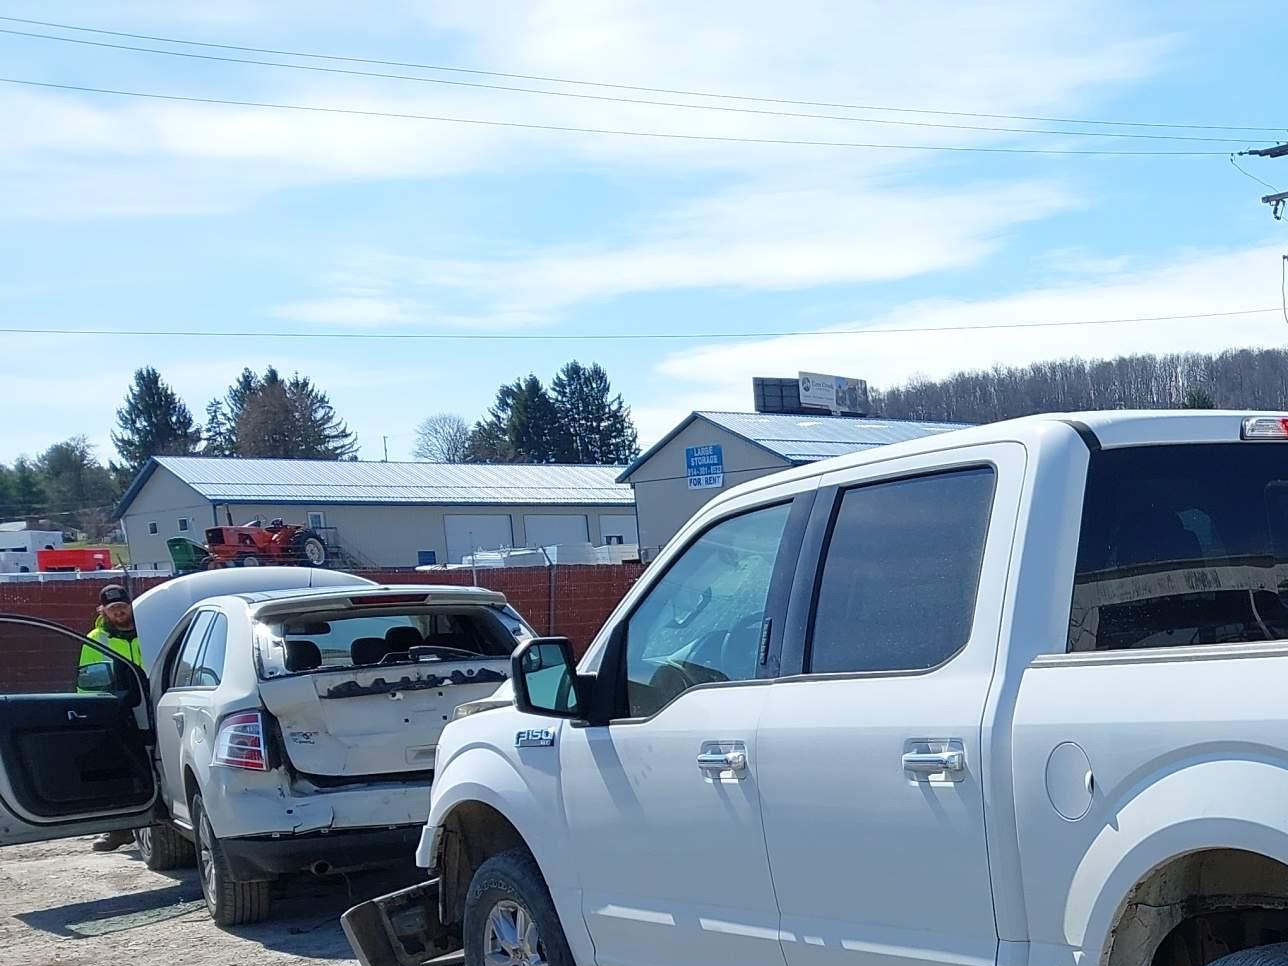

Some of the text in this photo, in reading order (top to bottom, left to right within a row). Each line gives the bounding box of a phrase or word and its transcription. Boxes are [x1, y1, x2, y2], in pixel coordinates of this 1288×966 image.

[690, 454, 718, 466] STORAGE
[689, 475, 721, 487] FOR RENT
